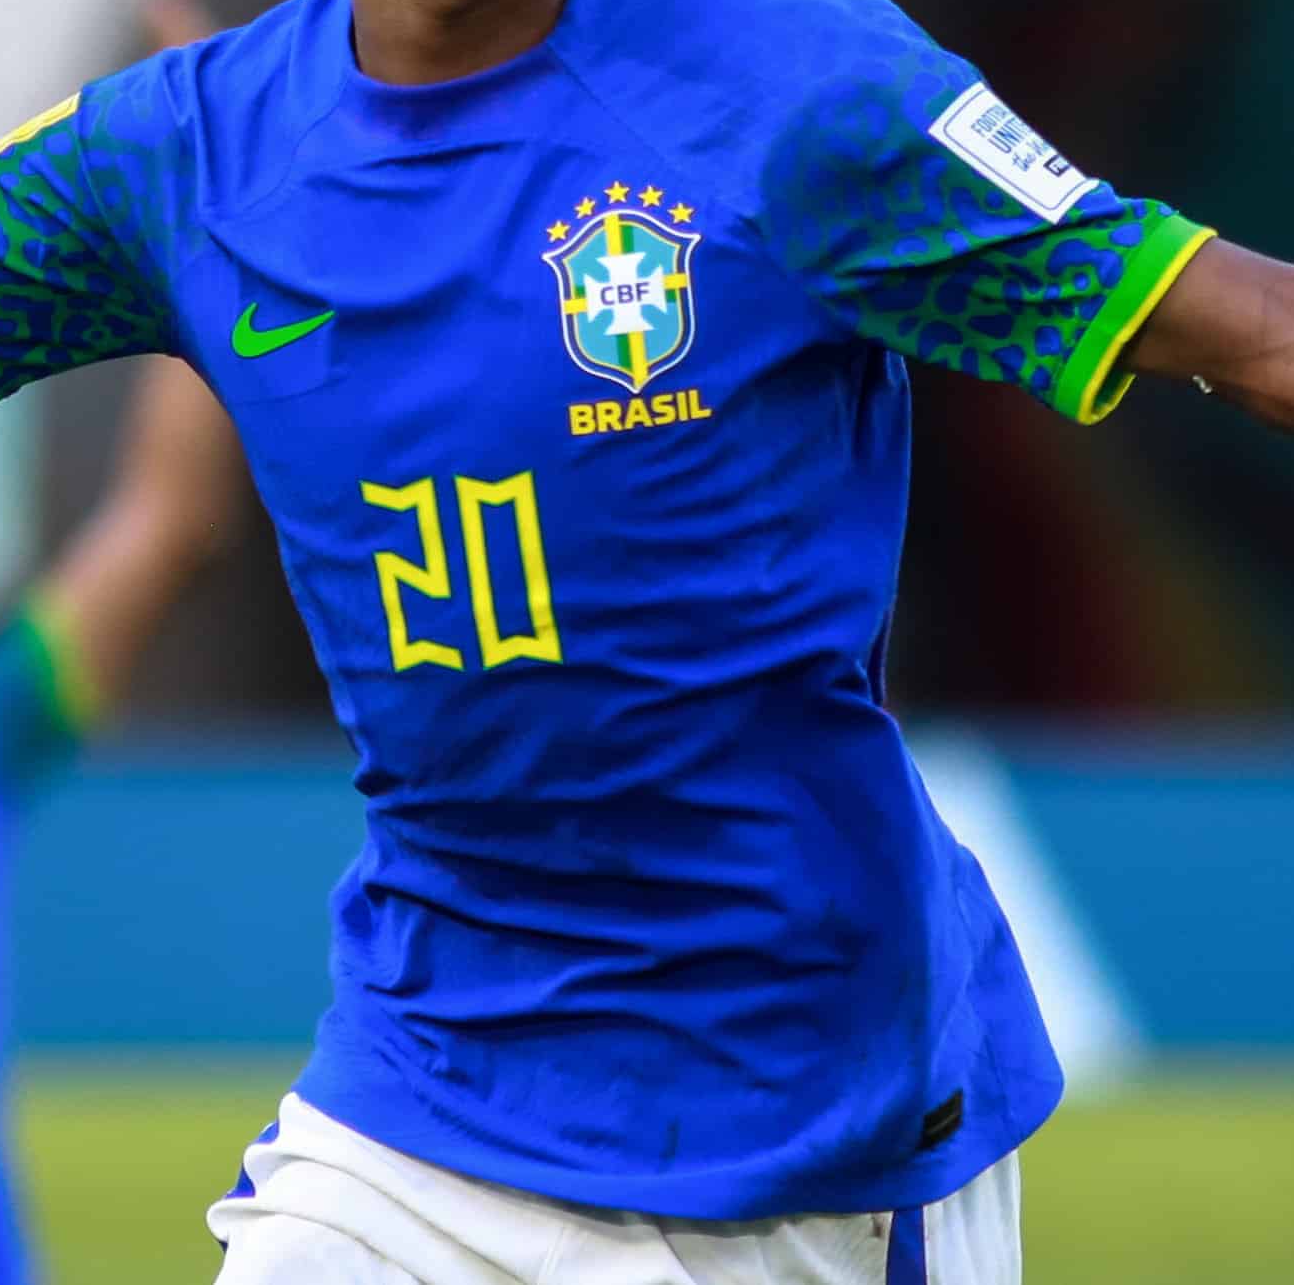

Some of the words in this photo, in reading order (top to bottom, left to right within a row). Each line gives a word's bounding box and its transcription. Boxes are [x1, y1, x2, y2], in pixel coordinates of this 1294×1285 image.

[599, 282, 650, 306] CBF
[568, 389, 713, 436] BRASIL
[358, 469, 564, 673] 20
